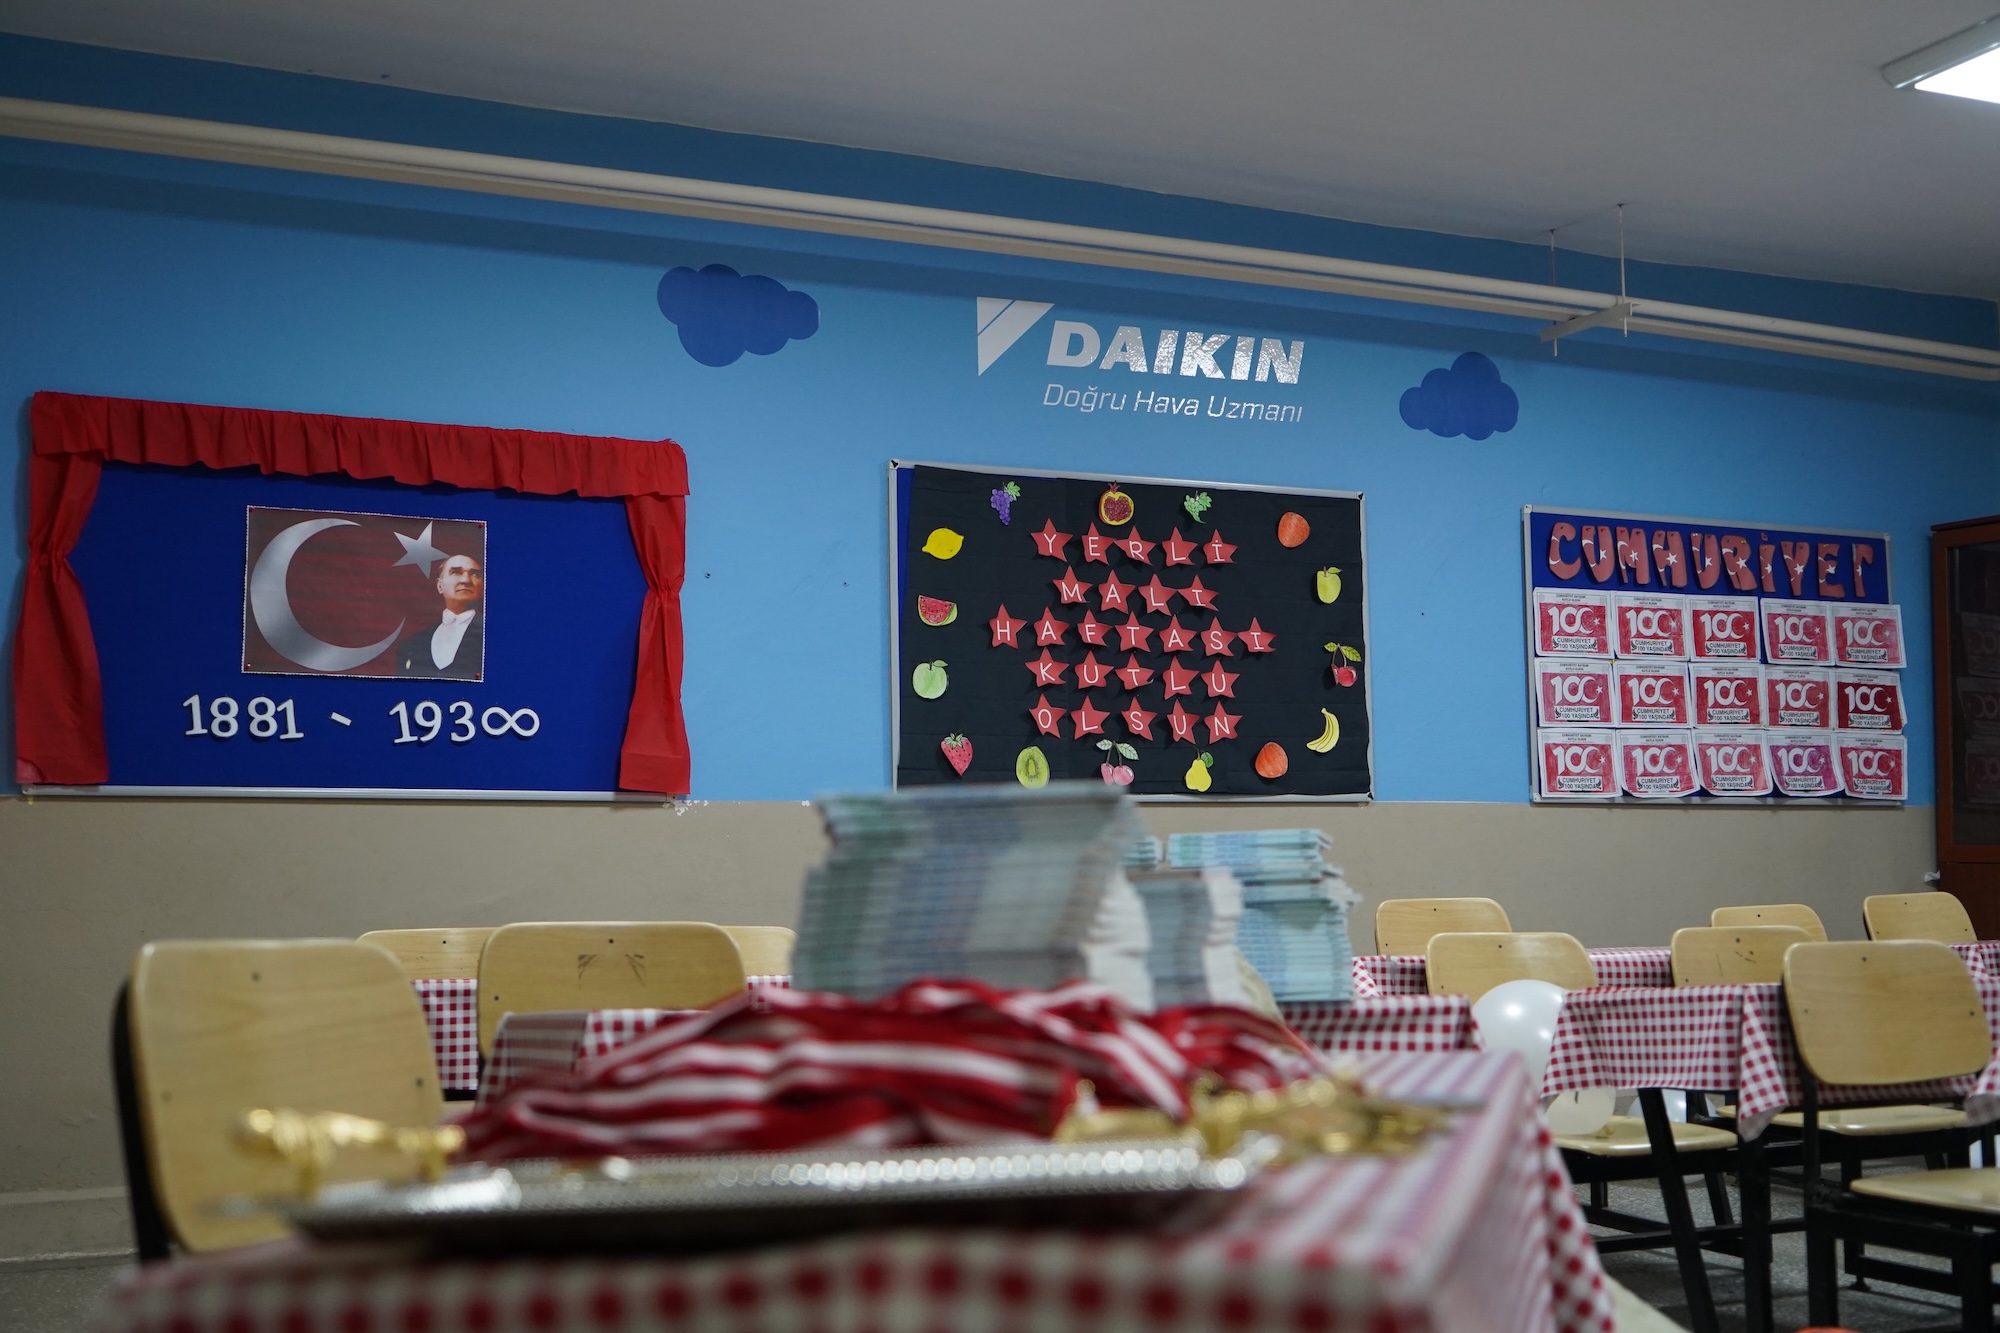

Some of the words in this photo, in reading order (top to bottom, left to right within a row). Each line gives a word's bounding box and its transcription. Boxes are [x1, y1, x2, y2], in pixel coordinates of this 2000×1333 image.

[1047, 320, 1304, 384] DAIKIN
[1044, 384, 1126, 412] Doğru
[1134, 390, 1199, 416] Hava
[1208, 396, 1302, 422] Uzmanı
[1043, 534, 1222, 561] YERLİ
[1062, 582, 1203, 607] MALI
[996, 620, 1262, 649] HAFTASI
[1040, 661, 1226, 693] KUTLU
[182, 693, 304, 740] 1881
[1038, 709, 1230, 736] OLSUN
